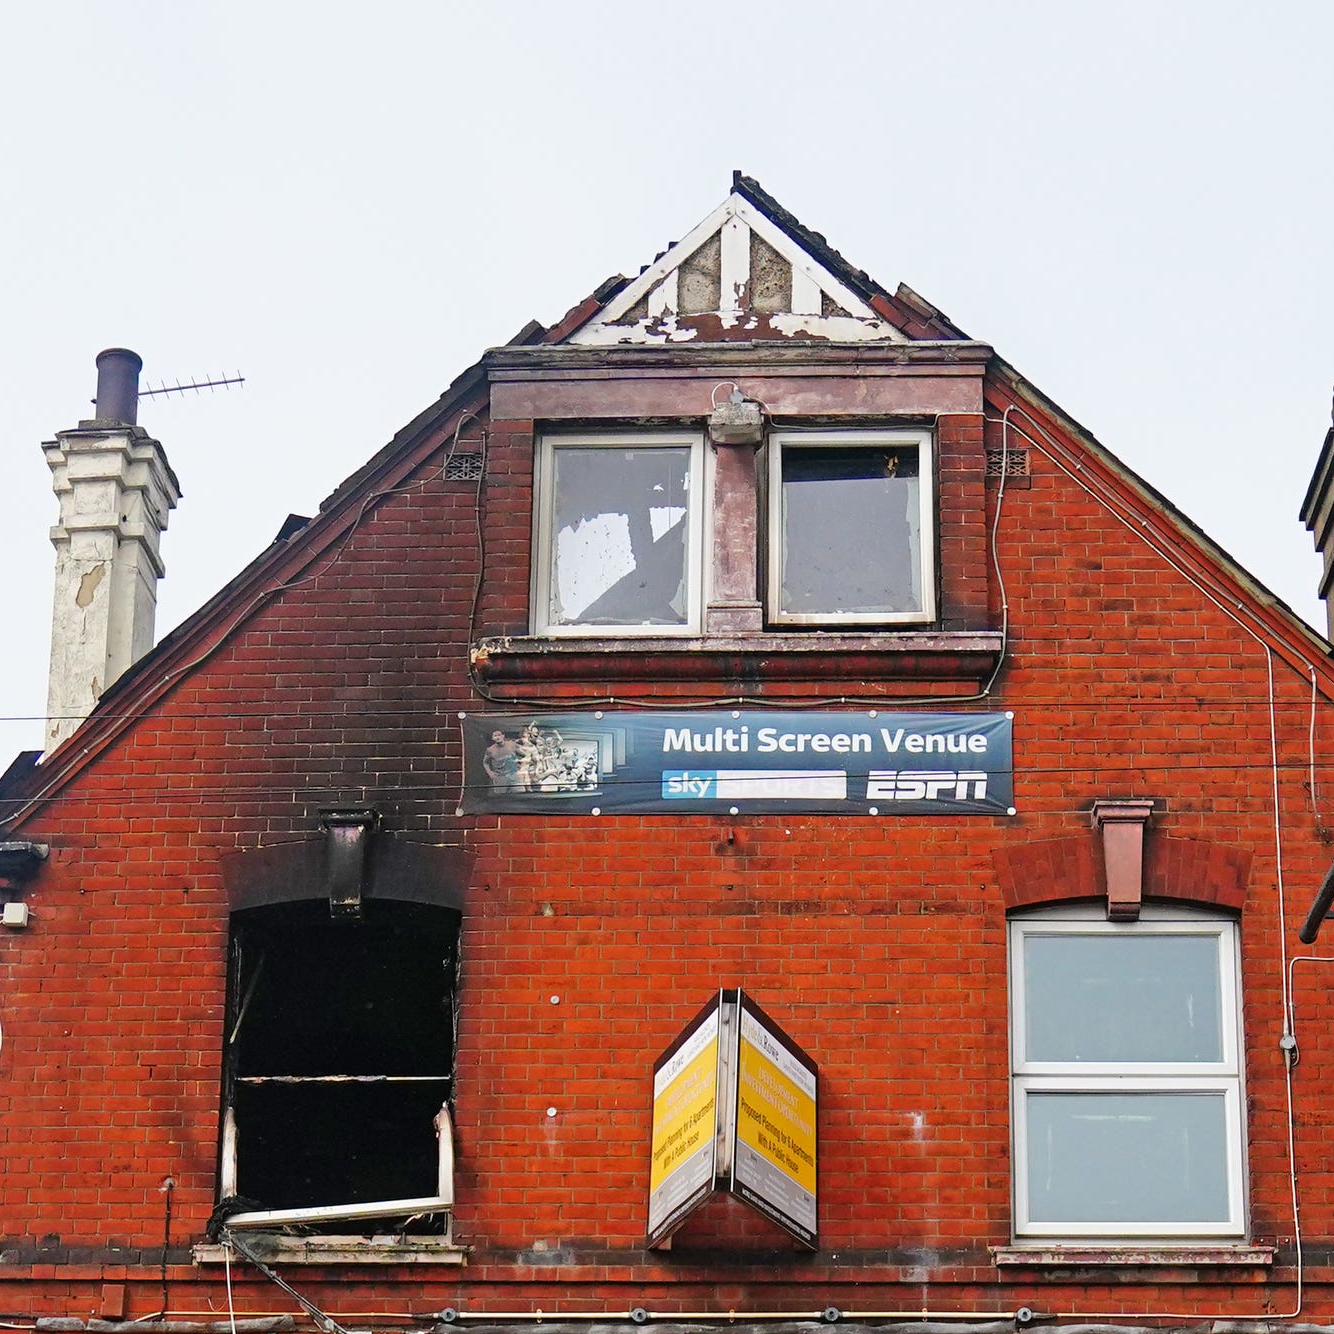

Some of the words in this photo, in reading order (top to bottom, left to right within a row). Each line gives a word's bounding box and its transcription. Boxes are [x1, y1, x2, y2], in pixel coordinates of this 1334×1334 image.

[662, 726, 749, 752] Multi
[758, 728, 871, 753] Screen
[880, 728, 988, 753] Venue
[667, 772, 713, 798] sky
[867, 770, 989, 800] ESPN
